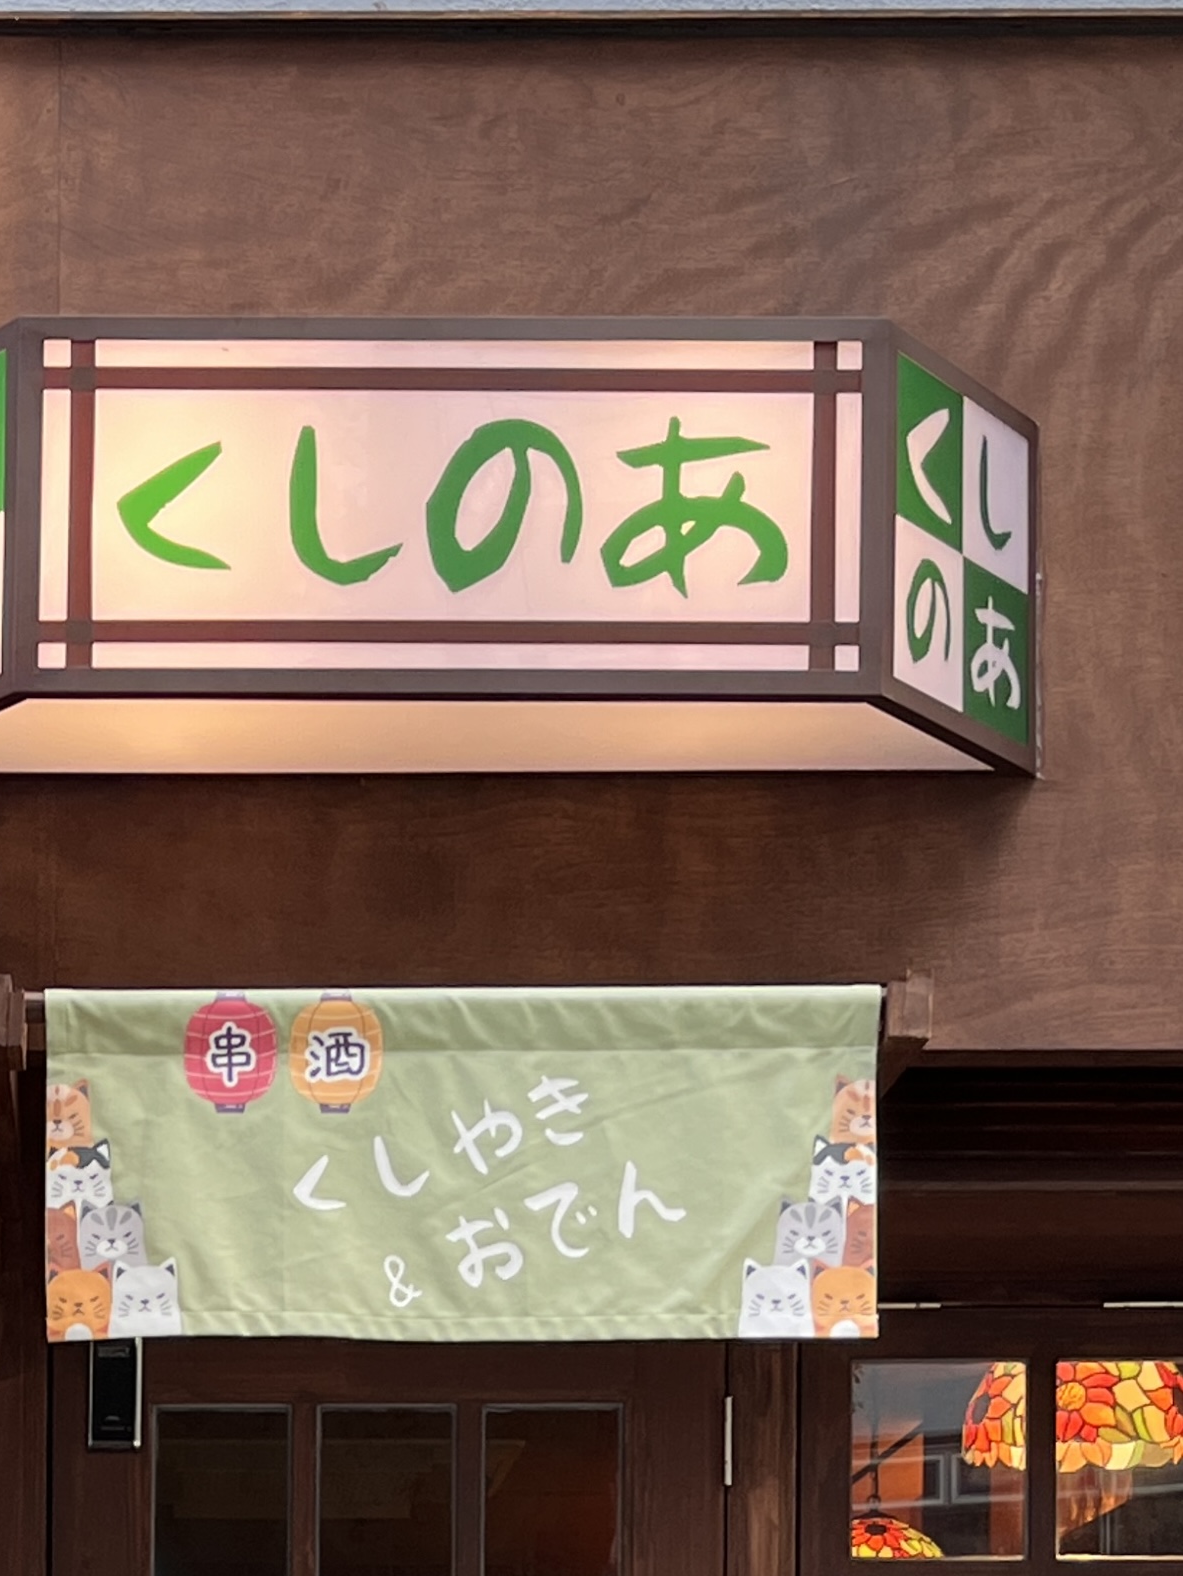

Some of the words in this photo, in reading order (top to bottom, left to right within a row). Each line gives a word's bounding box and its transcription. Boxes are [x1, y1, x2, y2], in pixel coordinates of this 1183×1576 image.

[117, 415, 790, 599] くしのあ
[207, 1024, 253, 1085] 串
[306, 1030, 367, 1081] 酒
[293, 1075, 595, 1213] くしやき
[385, 1254, 423, 1308] &
[446, 1161, 687, 1289] おでん
